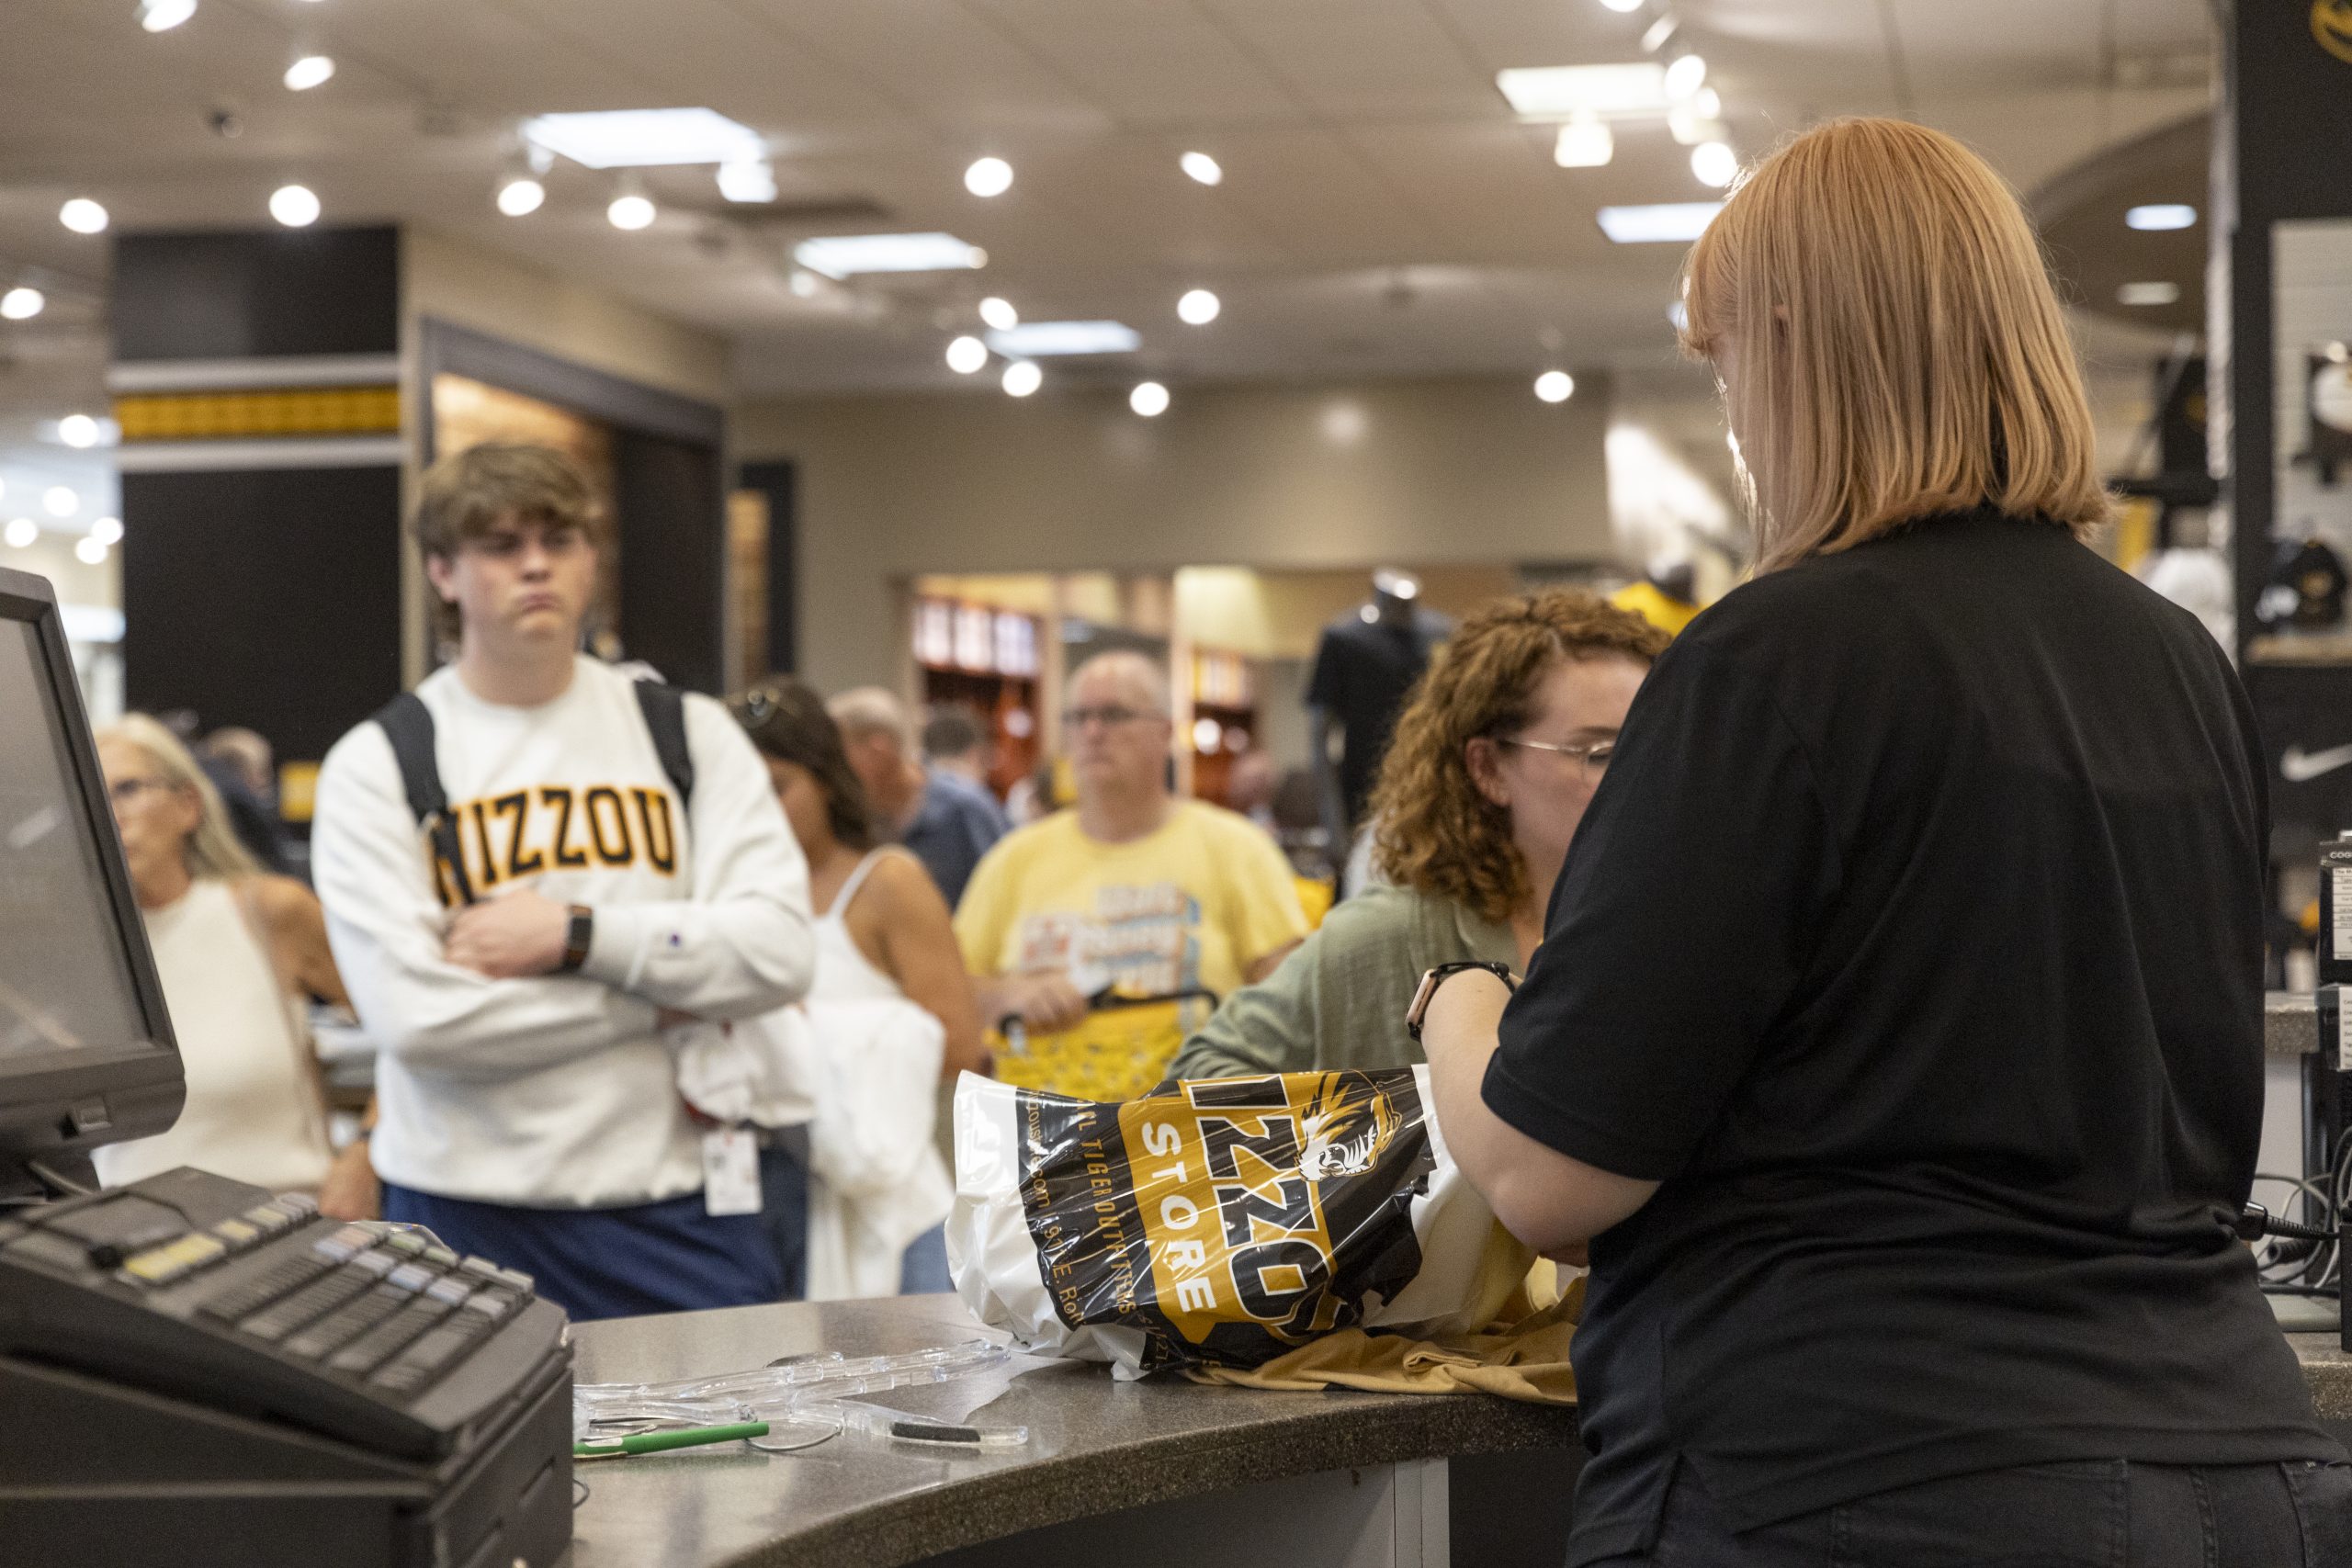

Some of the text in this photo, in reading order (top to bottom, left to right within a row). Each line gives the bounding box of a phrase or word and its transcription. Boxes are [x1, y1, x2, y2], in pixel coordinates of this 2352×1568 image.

[1080, 1138, 1113, 1198] TIGER
[1141, 1122, 1217, 1313] STORE
[1185, 1073, 1343, 1334] IZZO
